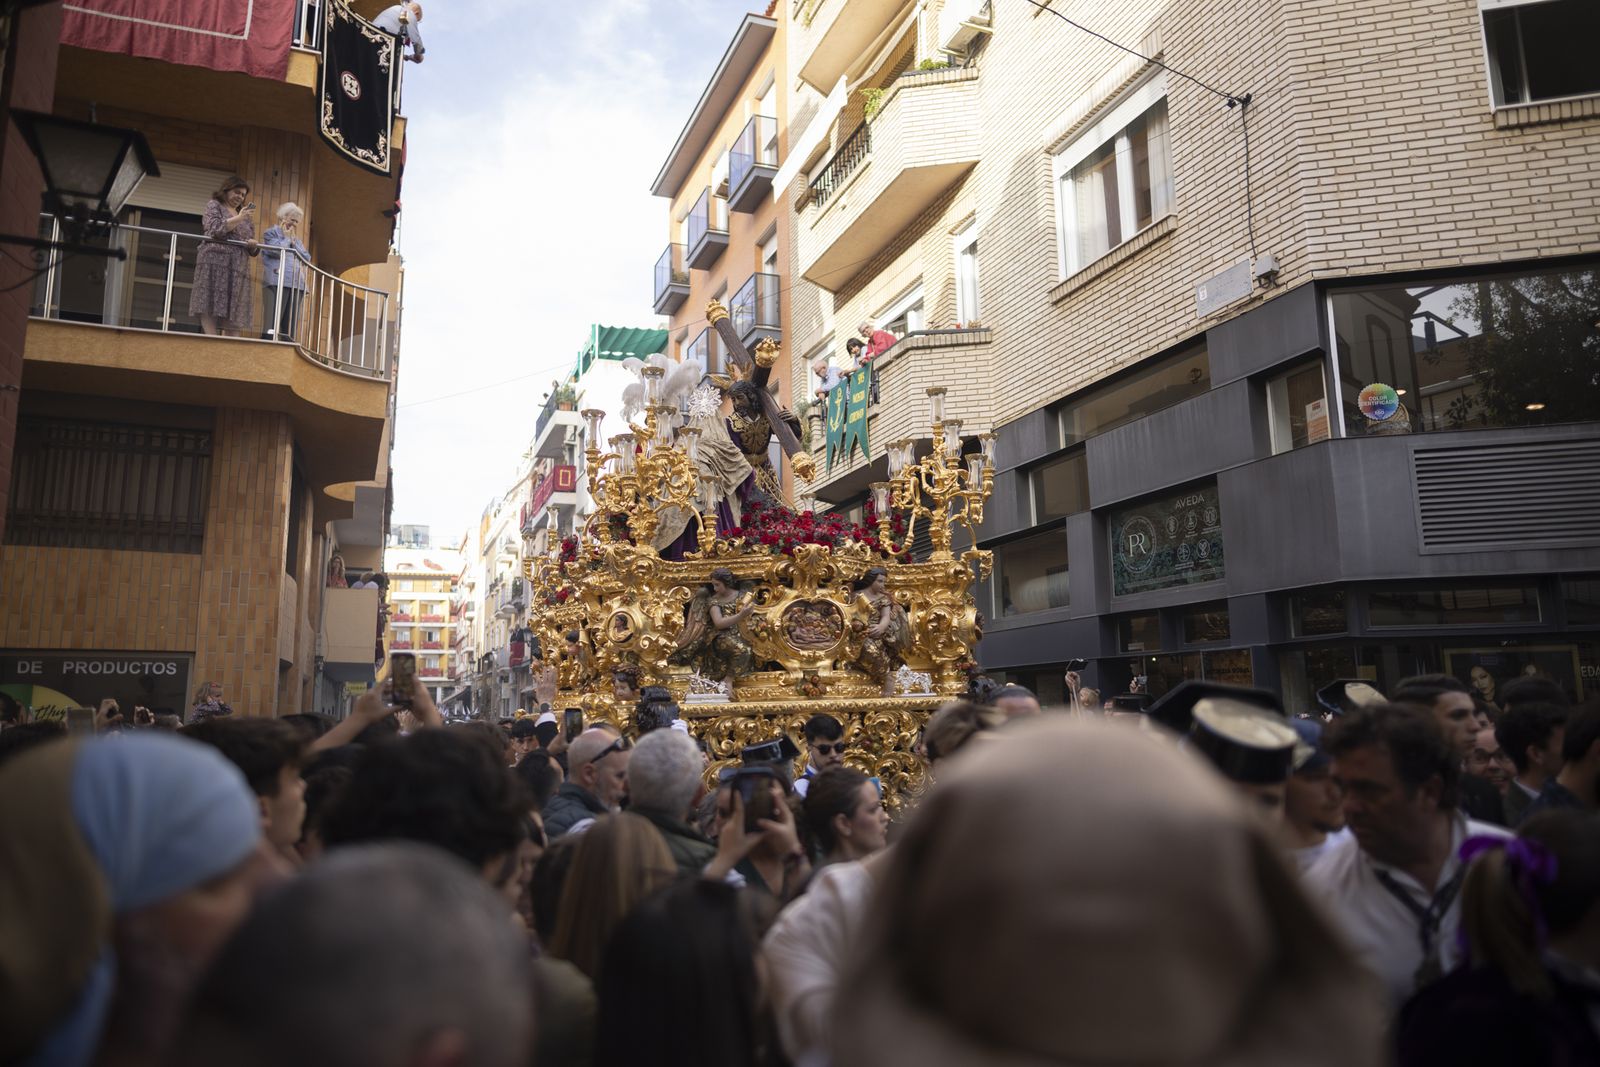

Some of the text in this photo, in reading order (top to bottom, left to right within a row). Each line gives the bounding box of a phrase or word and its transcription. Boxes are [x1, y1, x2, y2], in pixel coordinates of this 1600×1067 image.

[1175, 494, 1204, 509] AVEDA
[17, 661, 177, 675] DE PRODUCTOS
